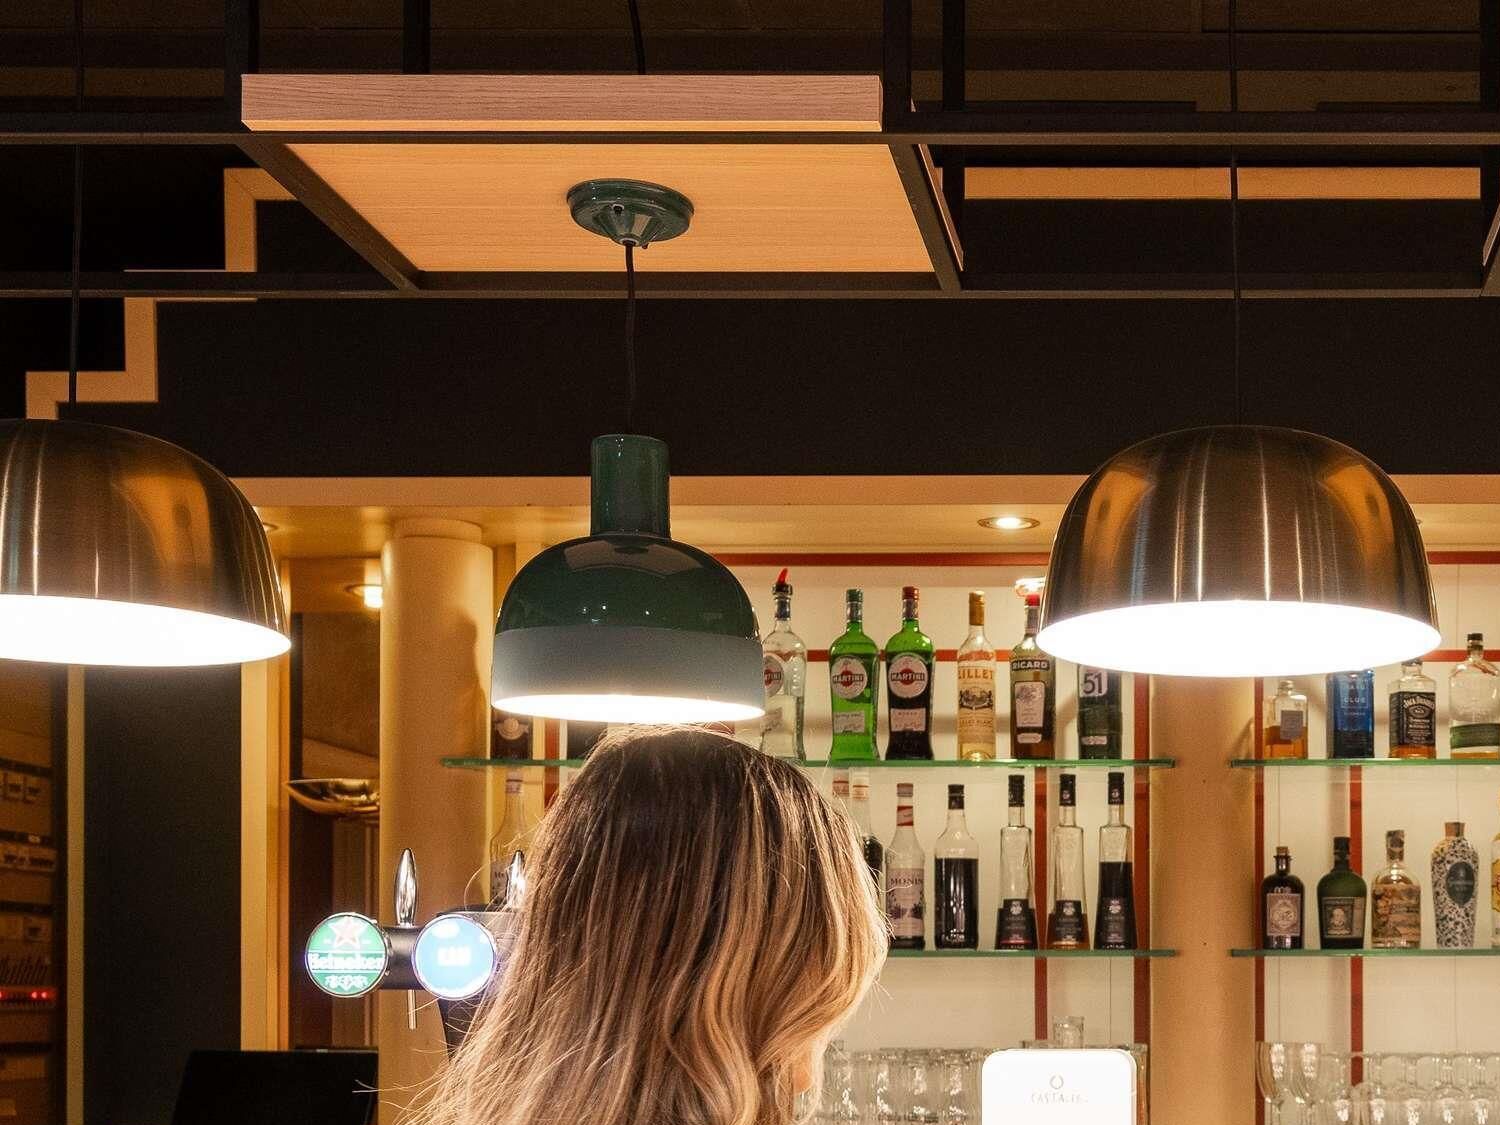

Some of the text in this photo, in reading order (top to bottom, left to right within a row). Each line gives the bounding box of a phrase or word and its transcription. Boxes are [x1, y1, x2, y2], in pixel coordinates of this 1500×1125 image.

[1012, 660, 1048, 671] RICARD
[832, 673, 864, 684] MARTINI
[890, 672, 925, 682] MARTINI
[1083, 672, 1103, 694] 51
